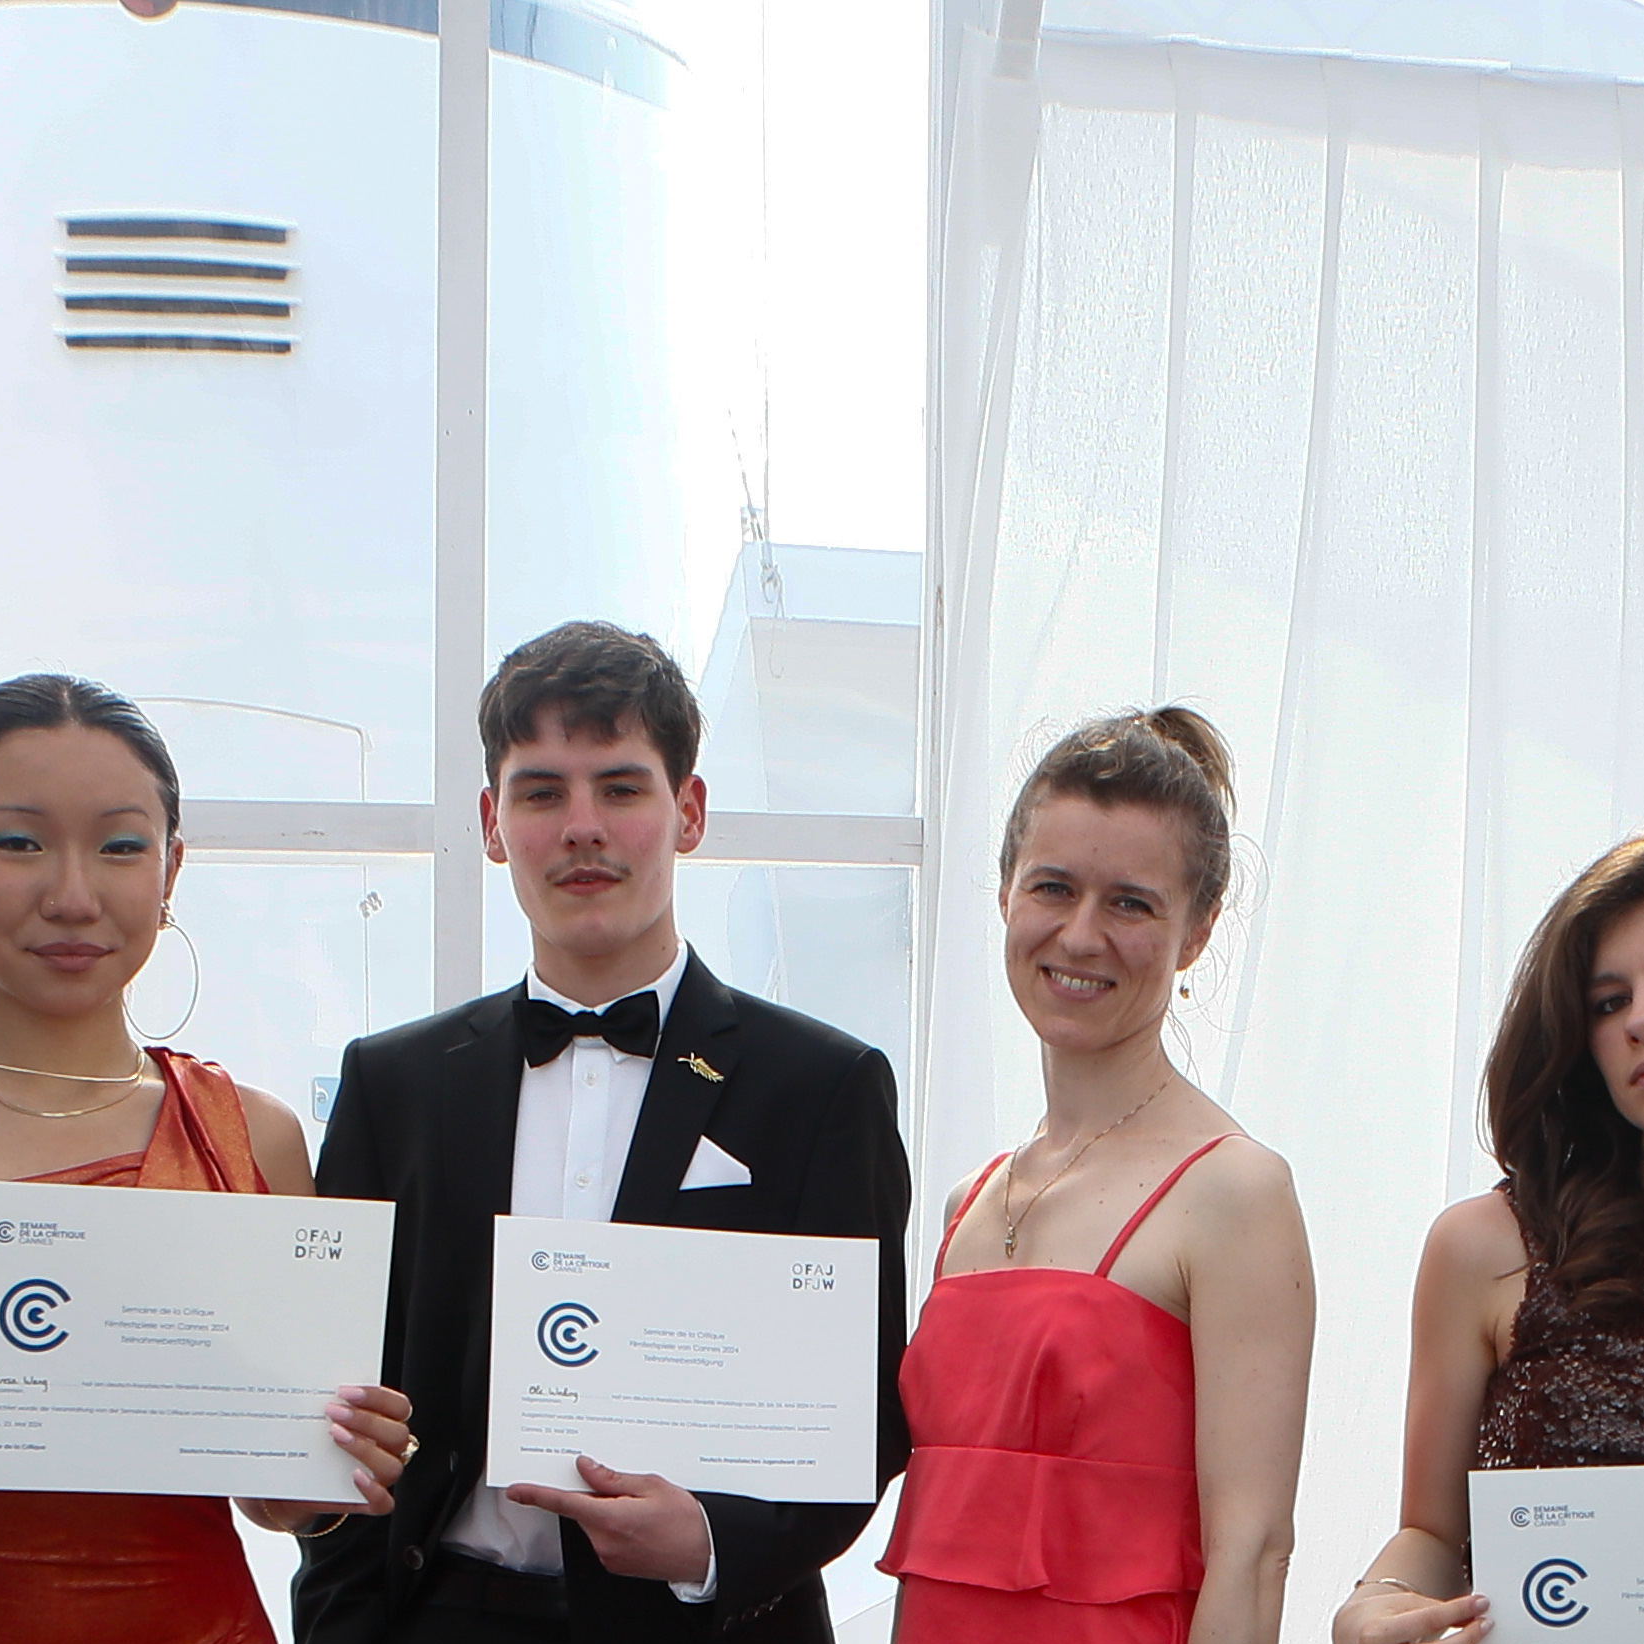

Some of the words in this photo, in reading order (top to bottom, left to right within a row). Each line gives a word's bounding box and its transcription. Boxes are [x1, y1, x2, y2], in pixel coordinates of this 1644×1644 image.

[20, 1222, 57, 1231] SEMAINE
[19, 1228, 30, 1237] DE
[45, 1229, 85, 1239] CRITIQUE
[296, 1229, 341, 1243] OFAJ
[19, 1236, 53, 1245] CANNES
[295, 1245, 342, 1259] DFJW
[792, 1263, 833, 1276] OFAJ
[793, 1278, 834, 1290] DFJW
[1534, 1505, 1568, 1513] SEMAINE
[1534, 1512, 1543, 1521] DE
[1558, 1511, 1594, 1519] CRITIQUE
